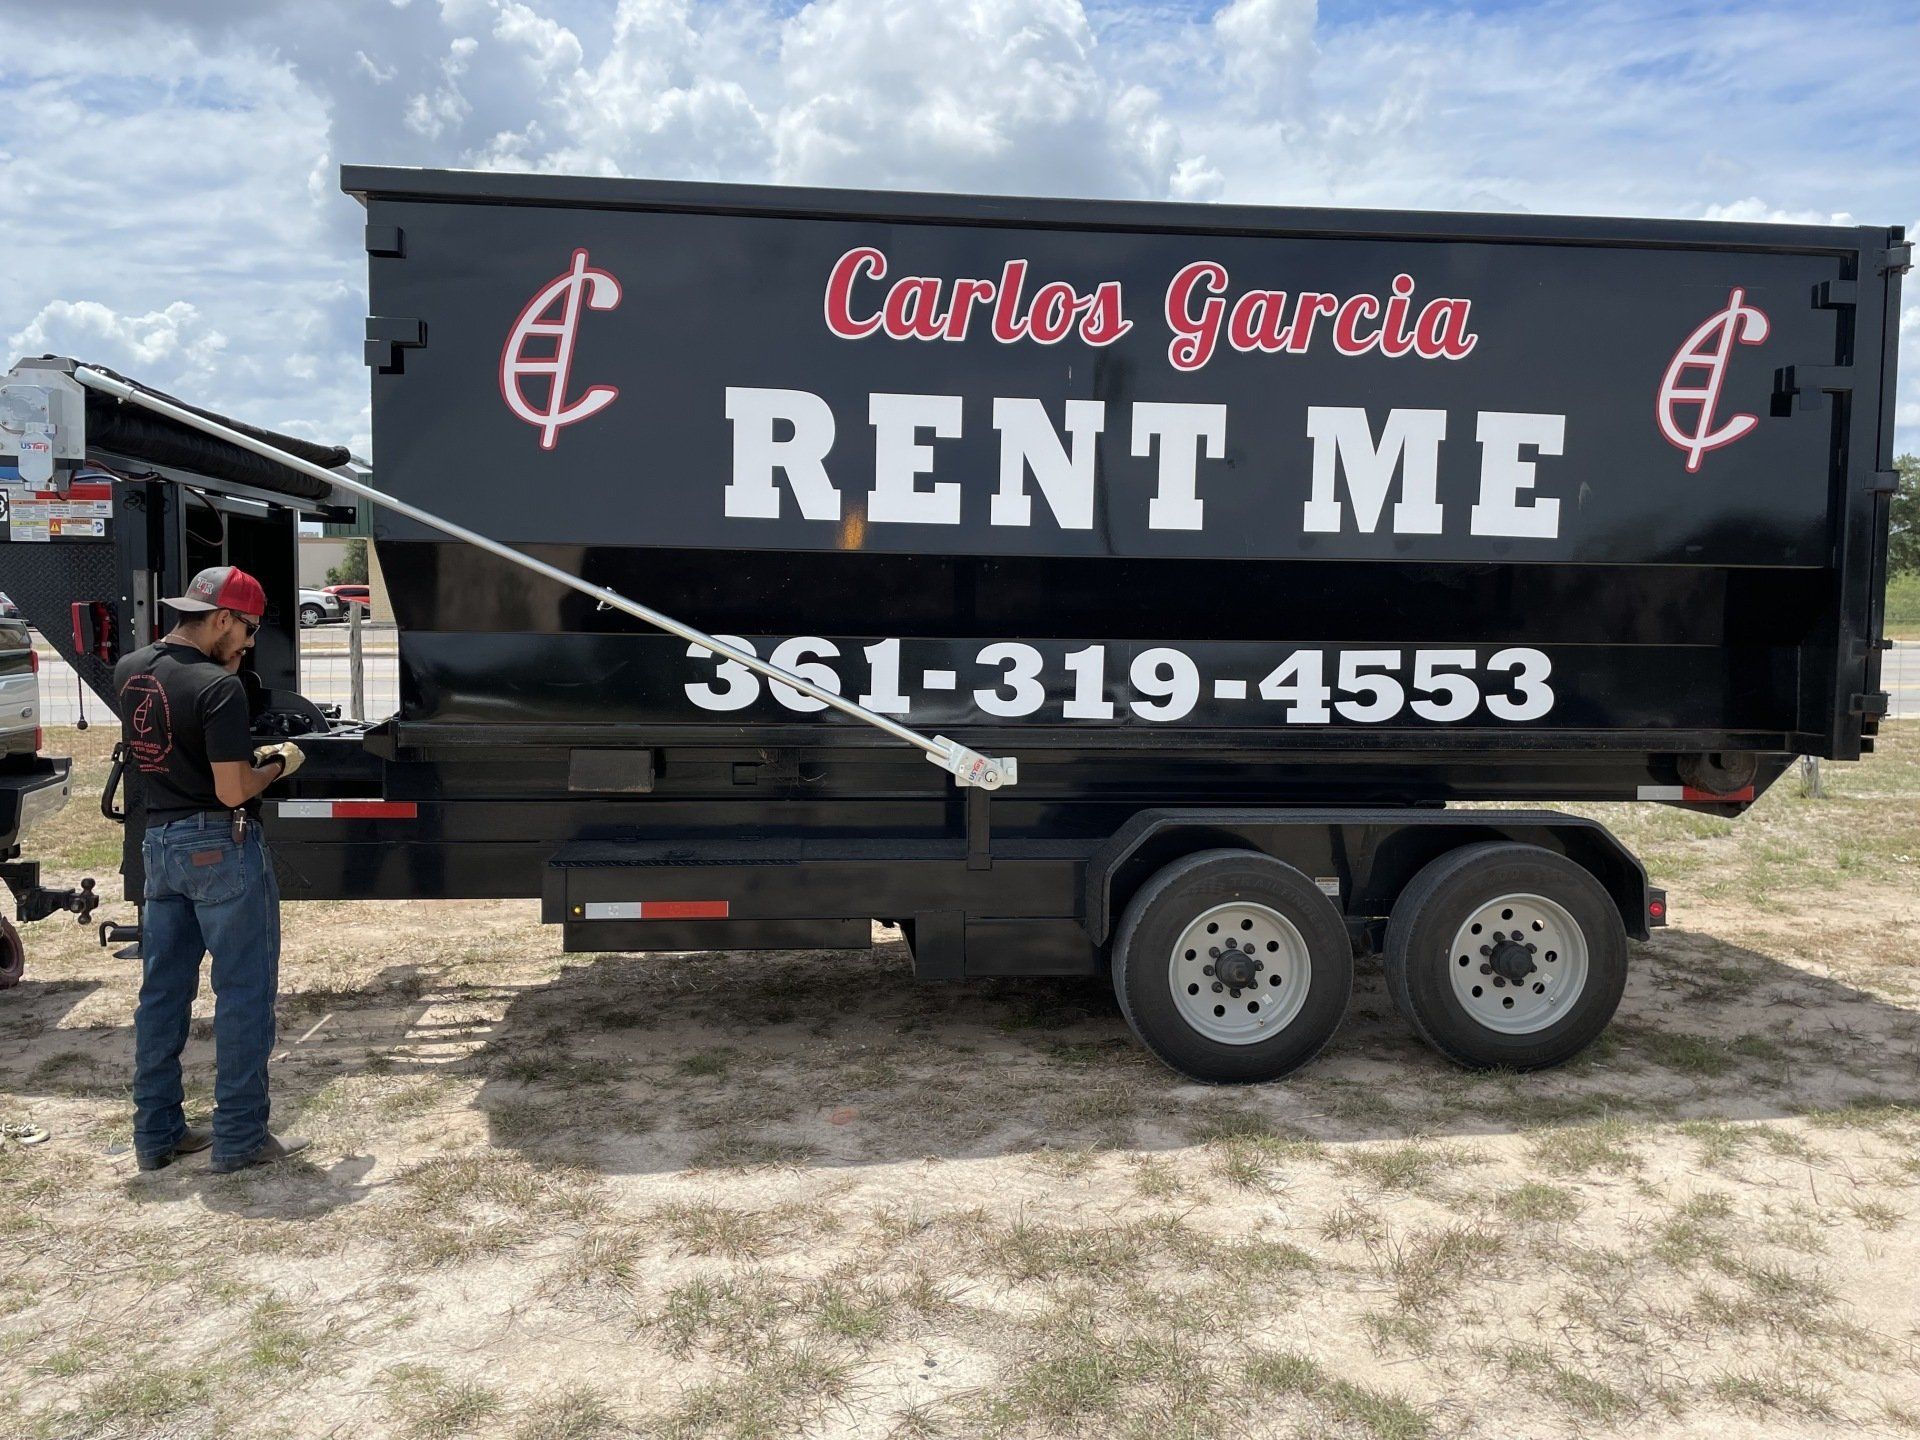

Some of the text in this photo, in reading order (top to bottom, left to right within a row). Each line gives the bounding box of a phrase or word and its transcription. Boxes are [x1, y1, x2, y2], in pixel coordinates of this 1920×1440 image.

[824, 247, 1478, 371] Carlos Garcia
[725, 387, 1565, 538] RENT ME
[685, 634, 1554, 724] 361-319-4553
